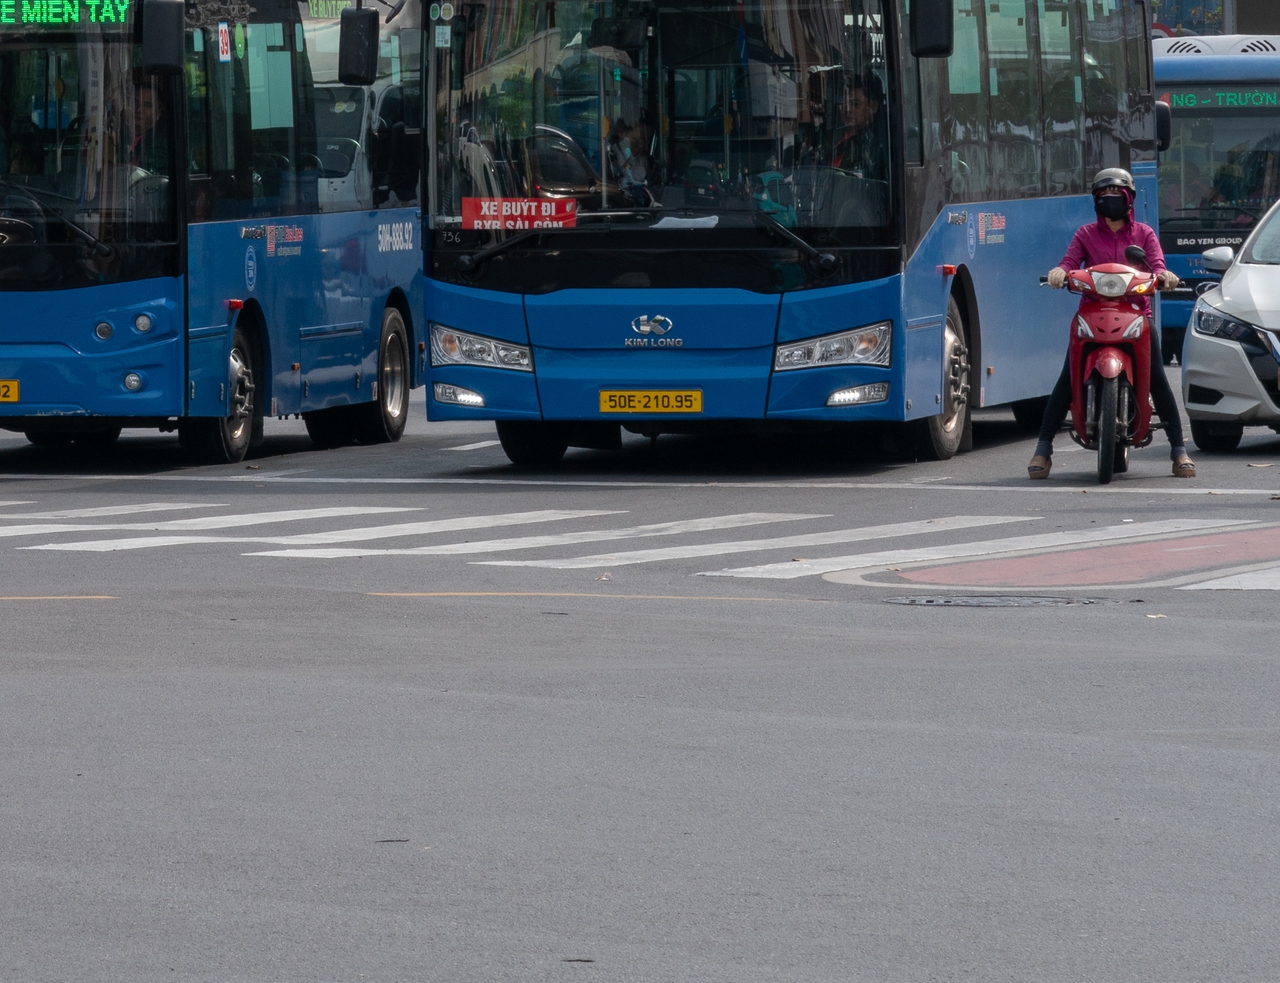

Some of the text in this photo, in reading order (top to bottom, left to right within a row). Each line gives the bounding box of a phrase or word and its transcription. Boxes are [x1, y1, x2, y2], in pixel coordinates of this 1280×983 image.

[220, 28, 229, 55] 39
[1172, 93, 1198, 107] NG
[480, 199, 555, 216] XE BUÝT ĐI
[378, 222, 412, 252] 50H-888.92
[1215, 237, 1243, 245] GROUP
[624, 338, 683, 347] KIM LONG
[608, 395, 693, 408] 50E-210.95
